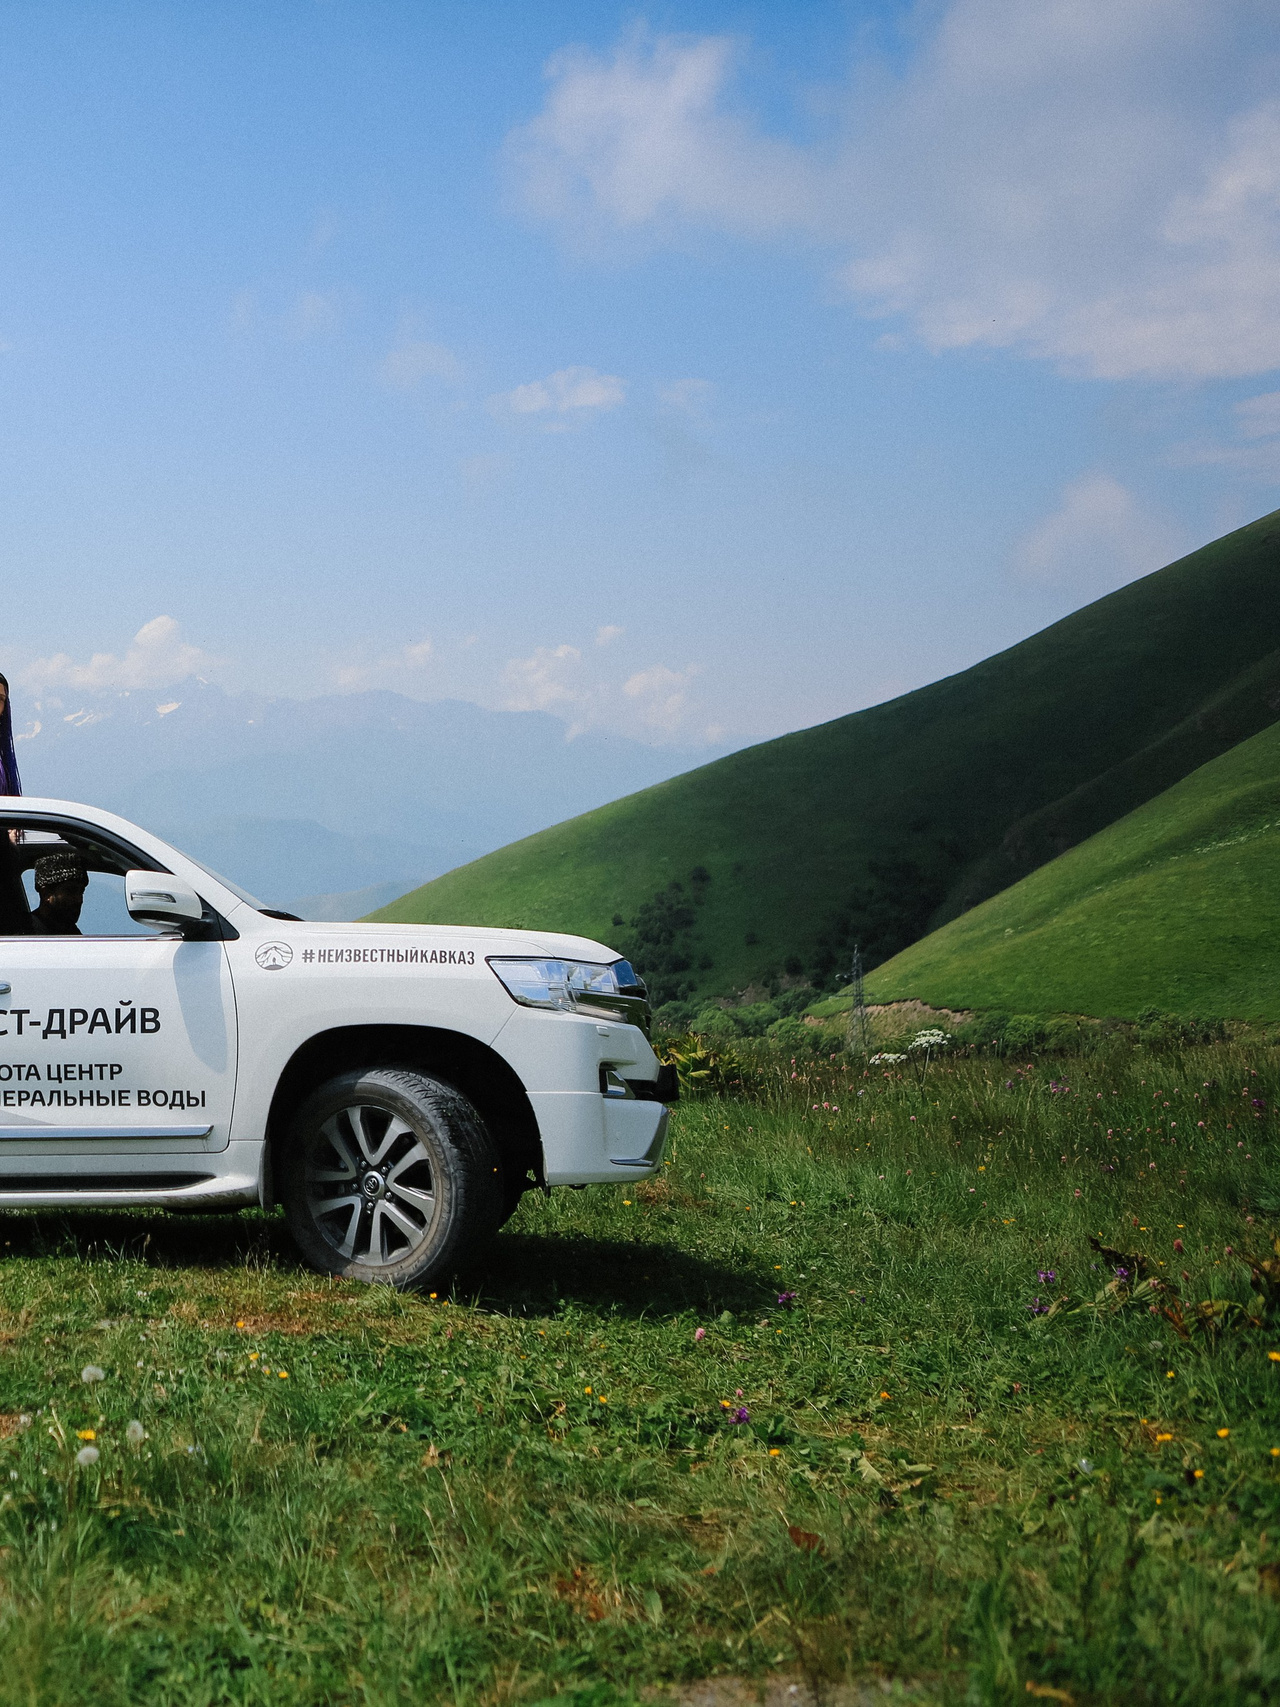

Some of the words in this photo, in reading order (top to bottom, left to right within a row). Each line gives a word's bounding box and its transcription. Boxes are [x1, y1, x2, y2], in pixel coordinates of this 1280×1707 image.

[301, 946, 476, 966] #НЕИЗВЕСТНЫЙКАВКАЗ
[46, 1063, 123, 1084] ЦЕНТР
[137, 1089, 206, 1110] ВОДЫ
